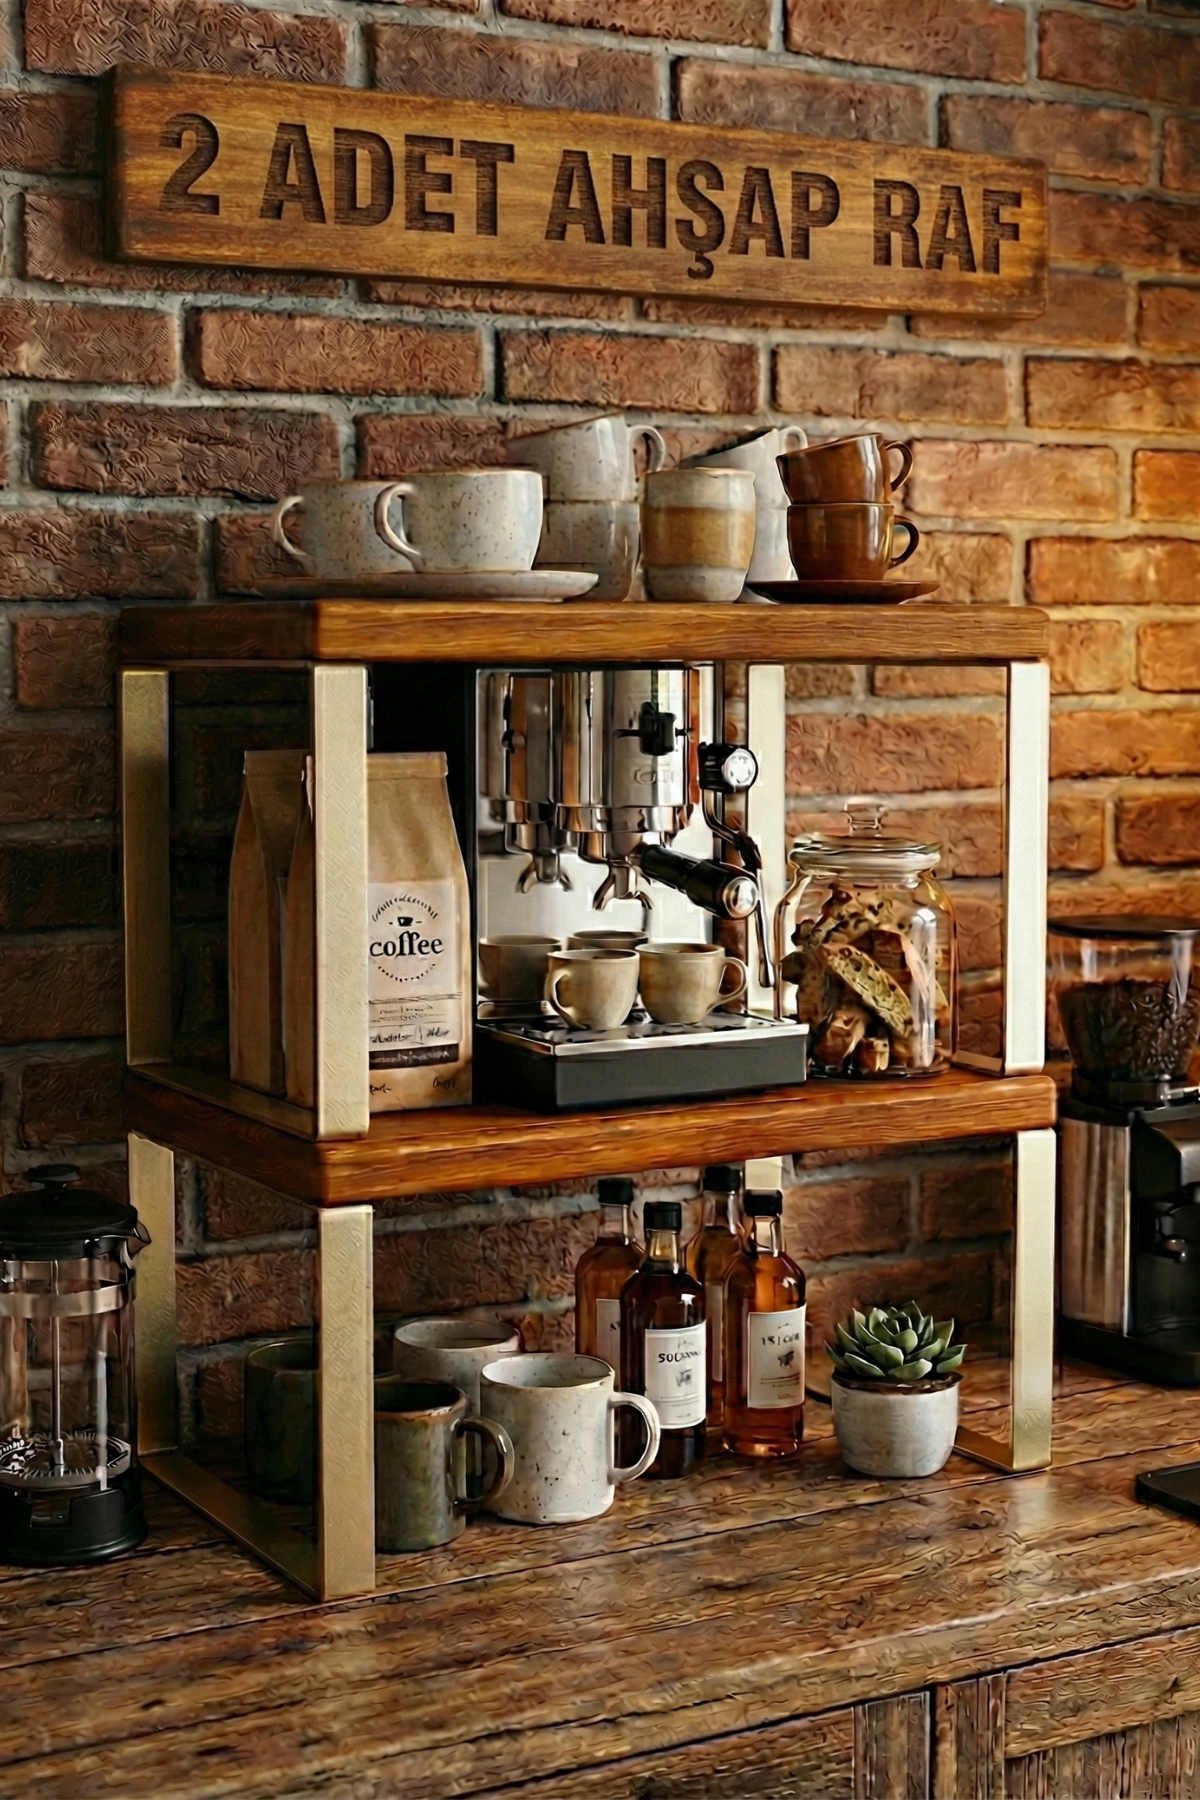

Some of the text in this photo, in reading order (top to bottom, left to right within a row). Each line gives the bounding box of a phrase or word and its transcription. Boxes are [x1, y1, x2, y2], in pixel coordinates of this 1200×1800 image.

[158, 112, 1023, 280] 2 ADET AHŞAP RAF
[369, 930, 444, 959] coffee
